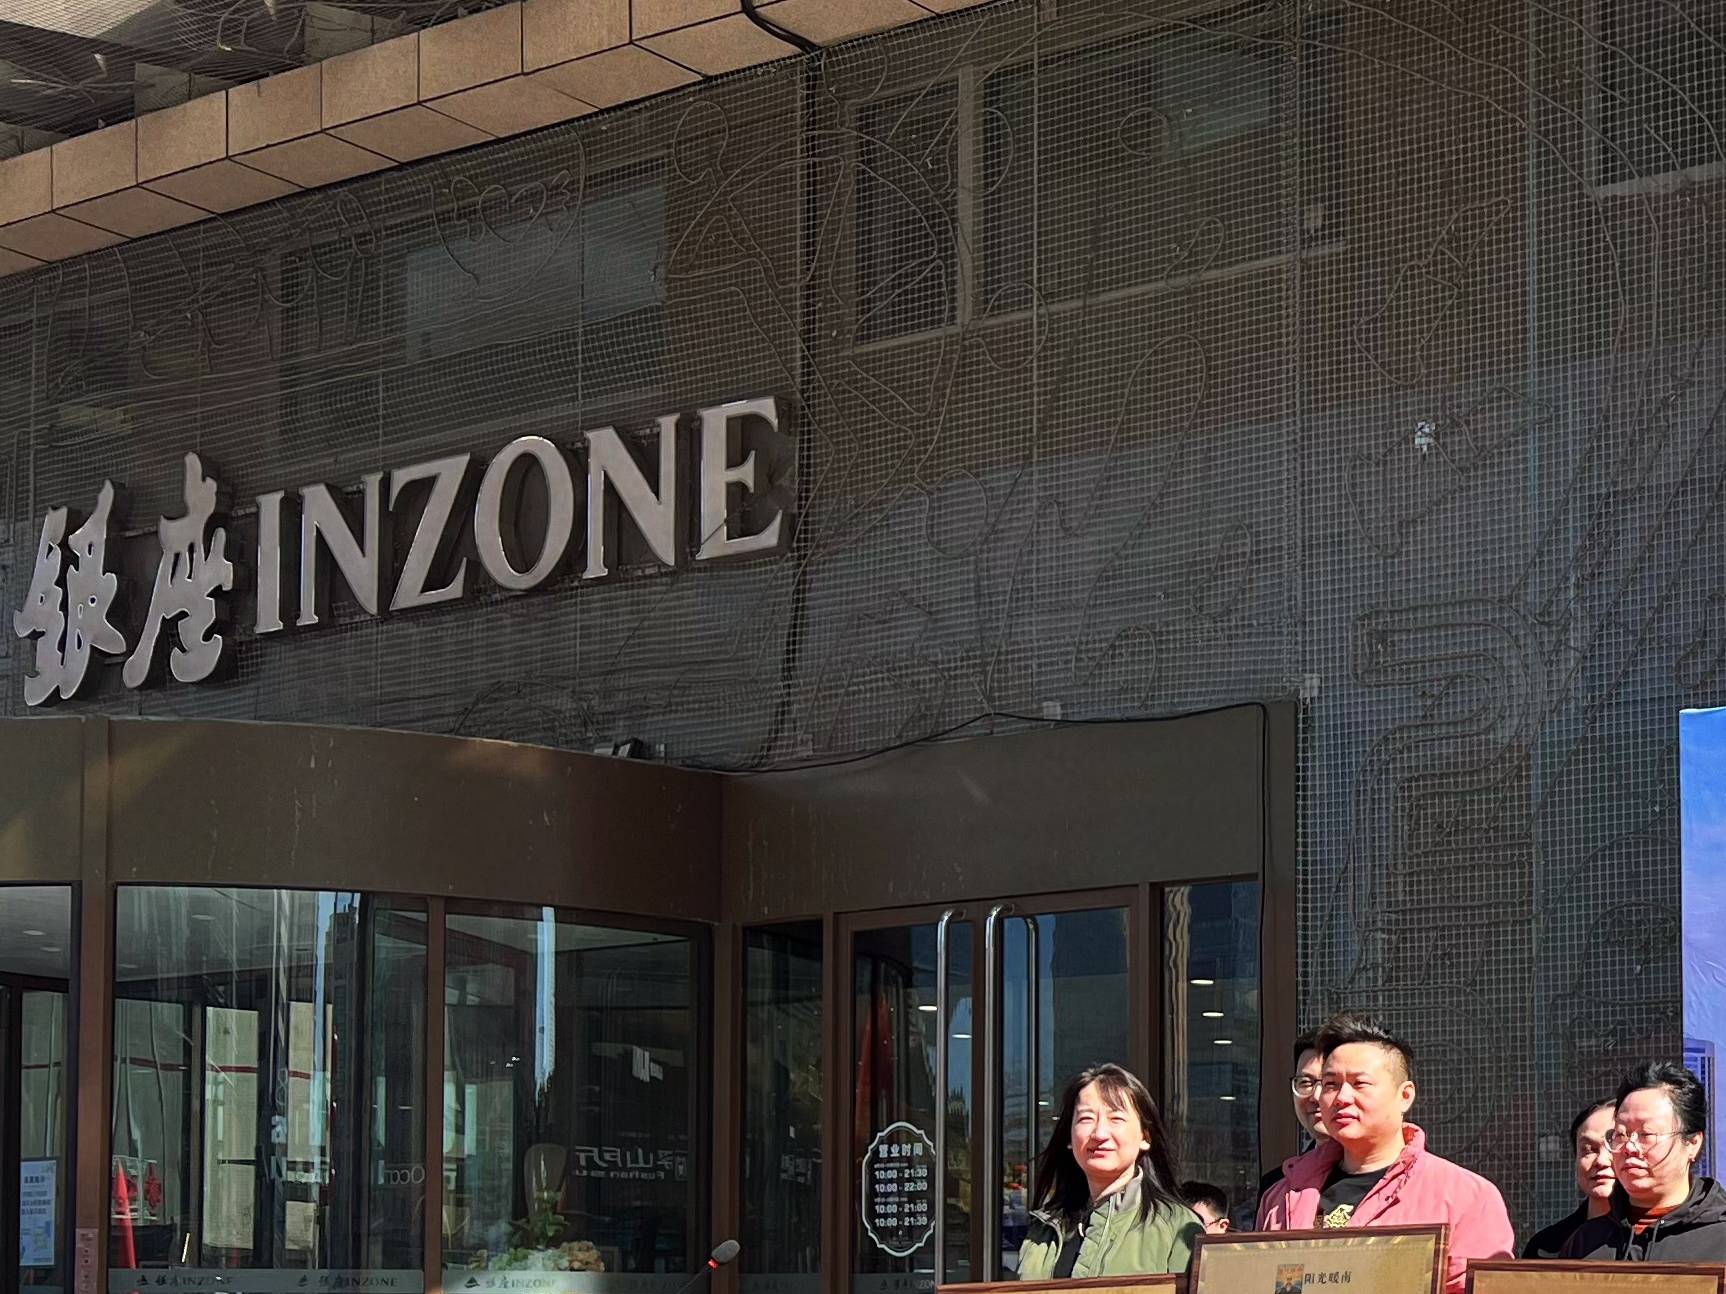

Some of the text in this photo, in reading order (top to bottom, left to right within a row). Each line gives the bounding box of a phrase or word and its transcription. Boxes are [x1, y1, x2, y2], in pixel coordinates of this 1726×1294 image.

[14, 396, 783, 706] 银座 INZONE
[879, 1142, 923, 1158] 营业时间
[875, 1169, 897, 1179] 10:00
[875, 1183, 897, 1192] 10:00
[904, 1182, 928, 1191] 22:00
[875, 1204, 898, 1214] 10:00
[904, 1203, 928, 1212] 21:00
[875, 1217, 898, 1227] 10:00
